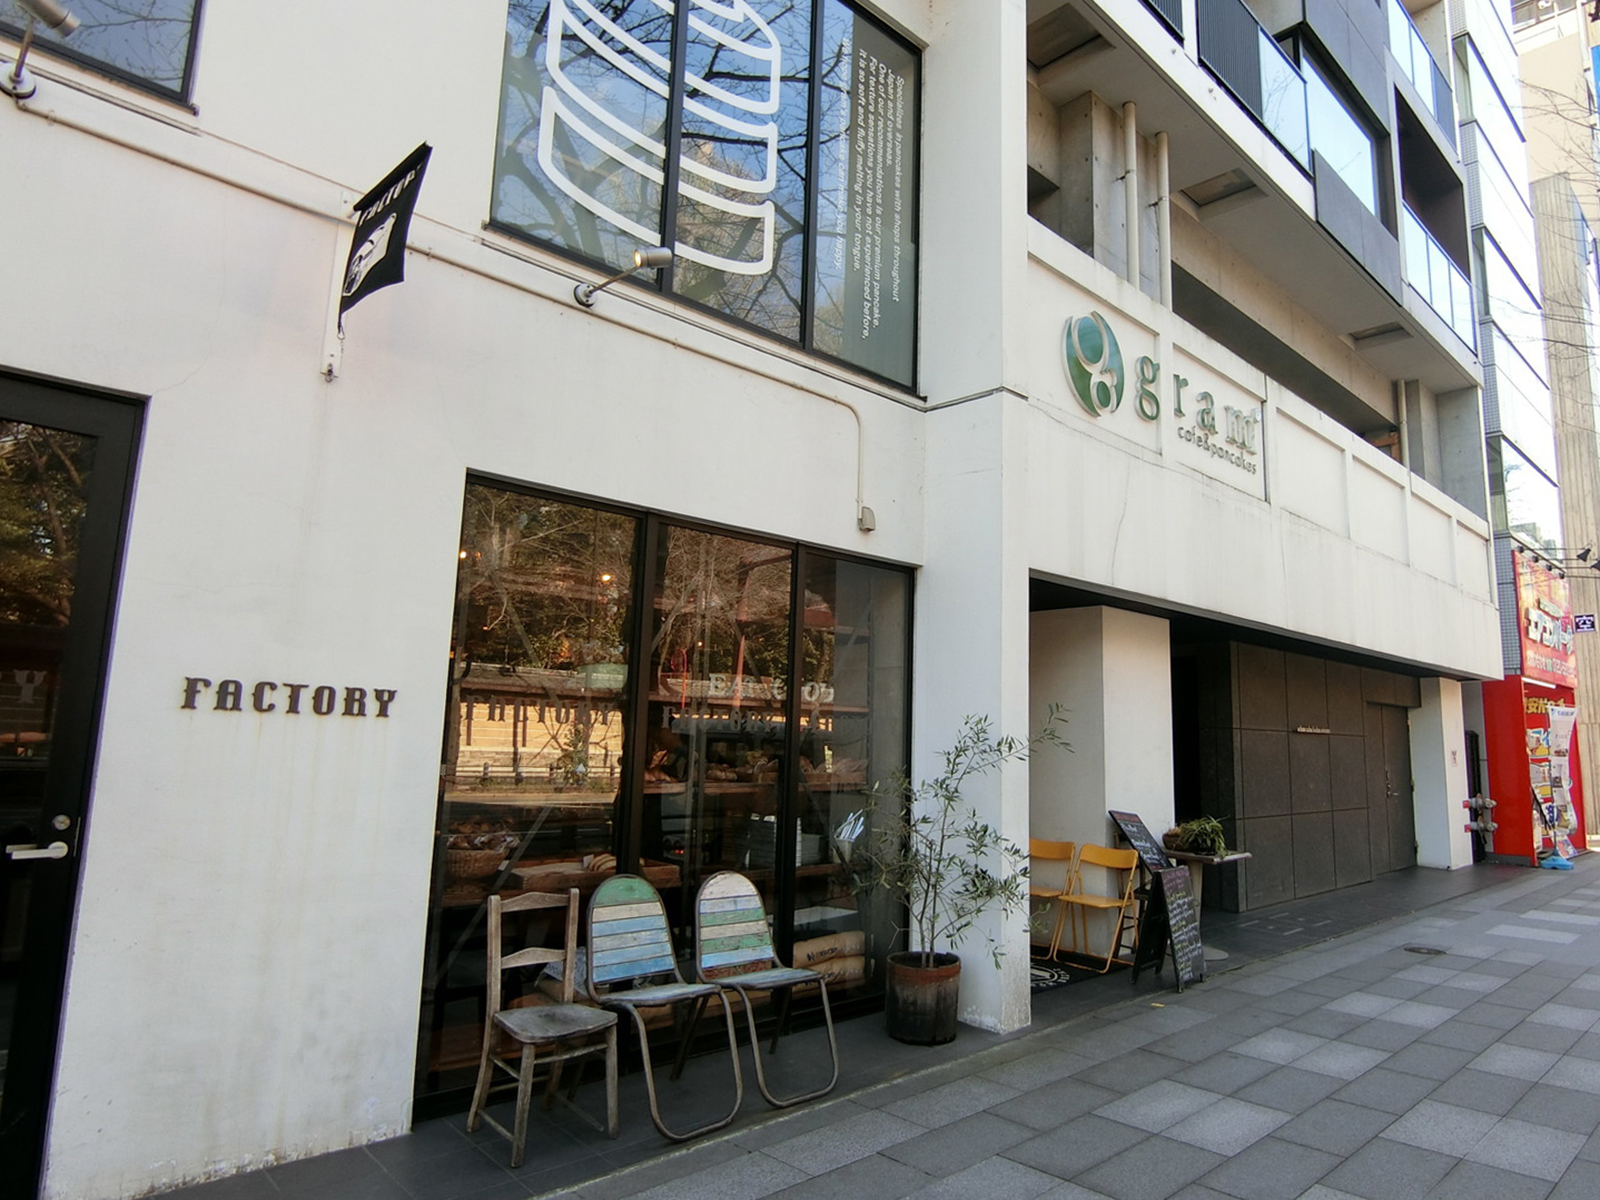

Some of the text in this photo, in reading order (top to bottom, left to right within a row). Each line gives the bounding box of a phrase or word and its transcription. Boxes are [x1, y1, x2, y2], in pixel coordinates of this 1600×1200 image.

[842, 38, 850, 51] We
[840, 55, 849, 79] hope
[859, 59, 867, 68] is
[859, 70, 866, 82] so
[869, 56, 877, 74] For
[878, 63, 886, 82] One
[858, 84, 866, 104] soft
[878, 85, 886, 96] of
[887, 69, 895, 98] Japan
[857, 106, 866, 125] and
[895, 76, 905, 129] Specializes
[839, 118, 847, 161] pancake
[855, 127, 865, 154] fluffy
[867, 113, 875, 167] sensations
[854, 155, 863, 193] melting
[875, 117, 884, 203] recommendations
[893, 141, 903, 188] pancakes
[865, 167, 874, 187] you
[837, 184, 845, 213] make
[866, 190, 874, 215] have
[875, 205, 883, 215] is
[893, 190, 902, 211] with
[836, 214, 844, 233] you
[853, 206, 863, 230] your
[892, 213, 902, 243] shops
[851, 232, 863, 272] tongue.
[873, 235, 882, 280] premium
[863, 236, 872, 300] experienced
[890, 246, 901, 302] throughout
[871, 282, 881, 328] pancake.
[1134, 355, 1260, 456] gram
[180, 676, 398, 718] FACTORY
